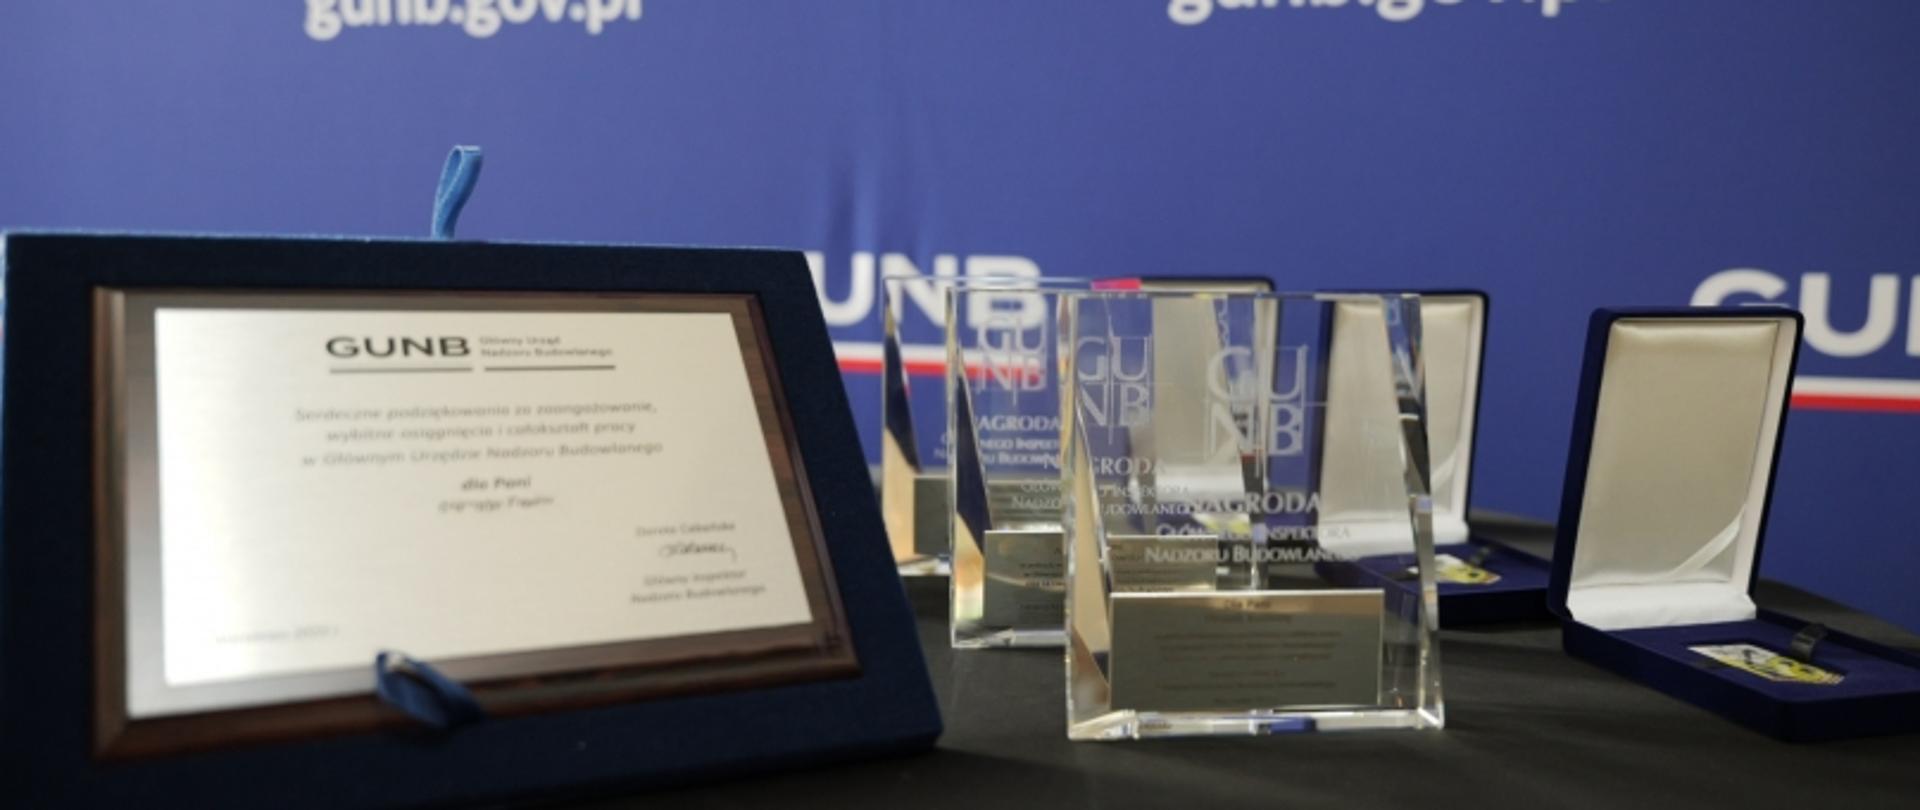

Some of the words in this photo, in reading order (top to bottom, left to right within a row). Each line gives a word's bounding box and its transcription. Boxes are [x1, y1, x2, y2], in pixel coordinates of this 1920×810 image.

[804, 251, 1047, 331] UNB
[325, 336, 471, 358] GUNB
[480, 346, 532, 358] Nadzoru
[535, 346, 614, 358] Budowlanego
[295, 408, 382, 423] Serdeczne
[387, 405, 511, 422] podziękowania
[594, 420, 637, 435] pracy
[974, 415, 1062, 432] AGRODA
[486, 443, 555, 460] Nadzoru
[559, 439, 664, 458] Budowlanego
[494, 475, 532, 490] Pani
[1144, 545, 1230, 563] NADZORU
